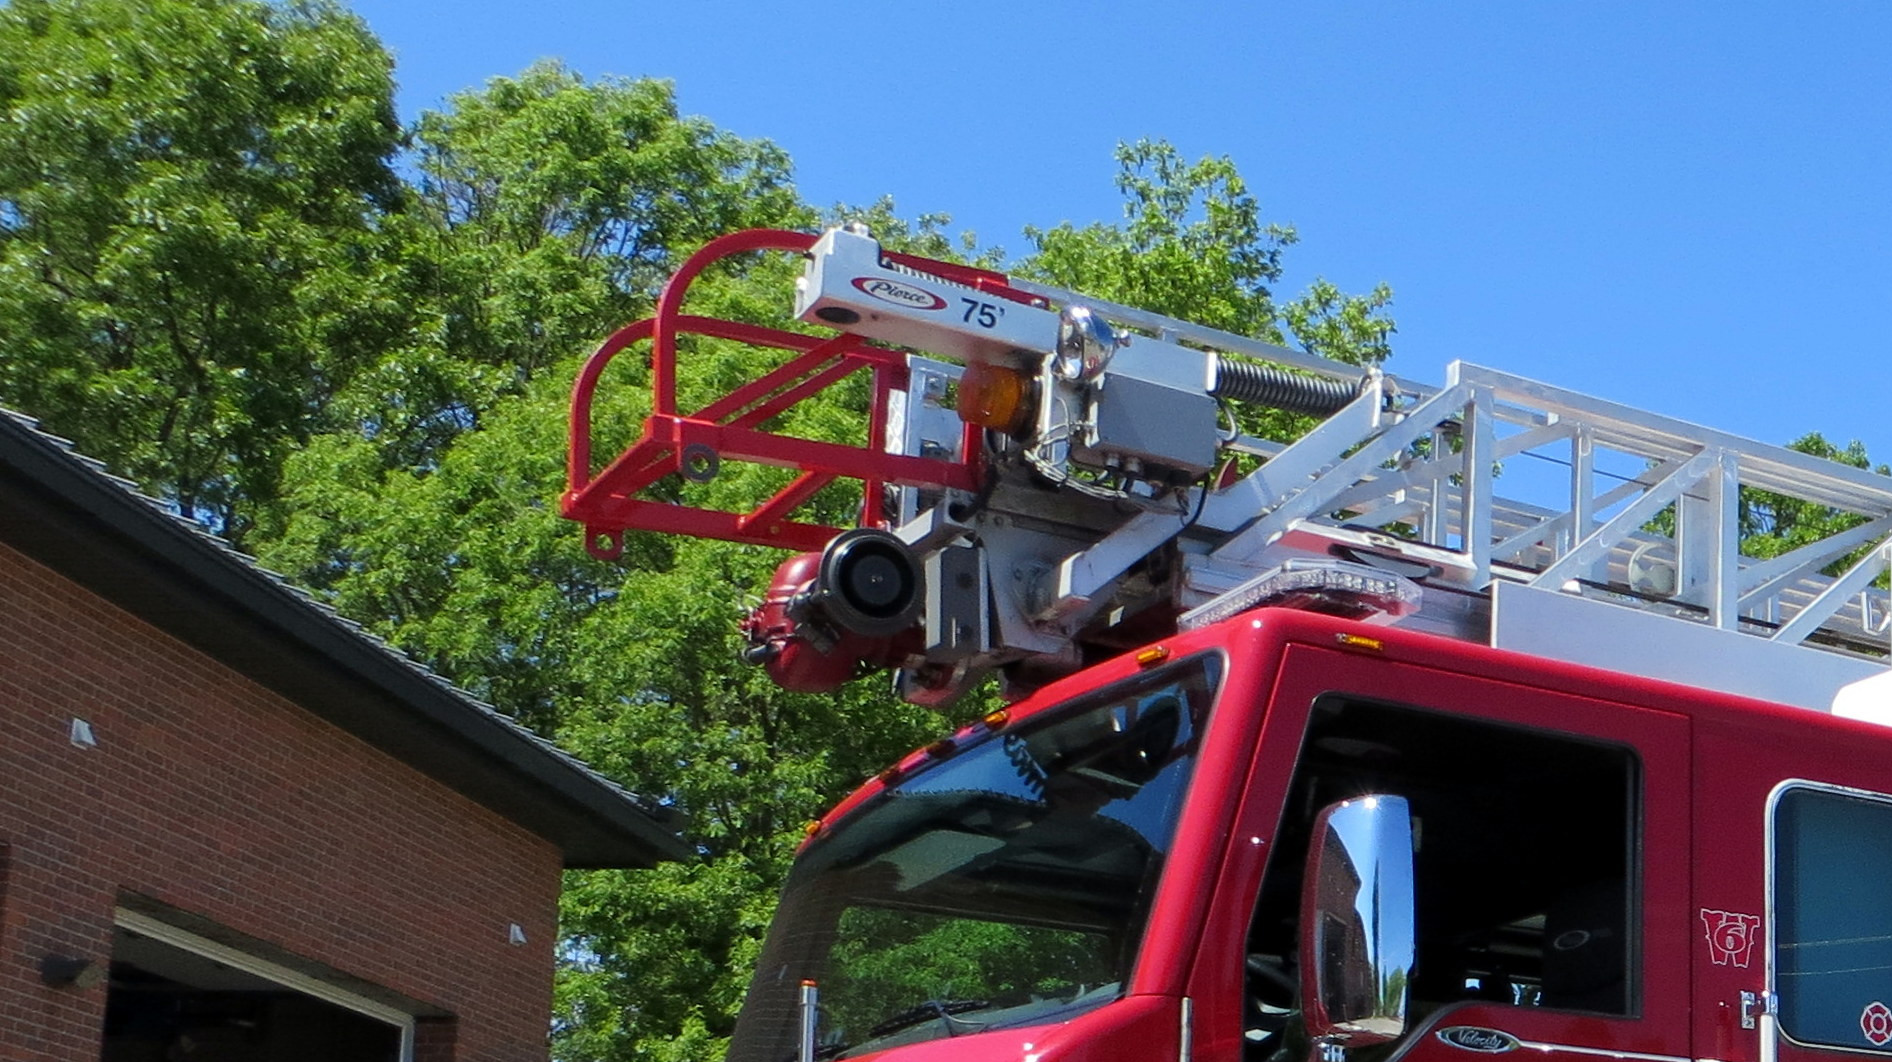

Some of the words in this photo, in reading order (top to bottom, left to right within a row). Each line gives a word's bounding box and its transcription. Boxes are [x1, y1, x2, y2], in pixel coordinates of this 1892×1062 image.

[870, 280, 927, 304] Pierce
[961, 297, 1006, 329] 75'
[1459, 1029, 1502, 1048] Velocity
